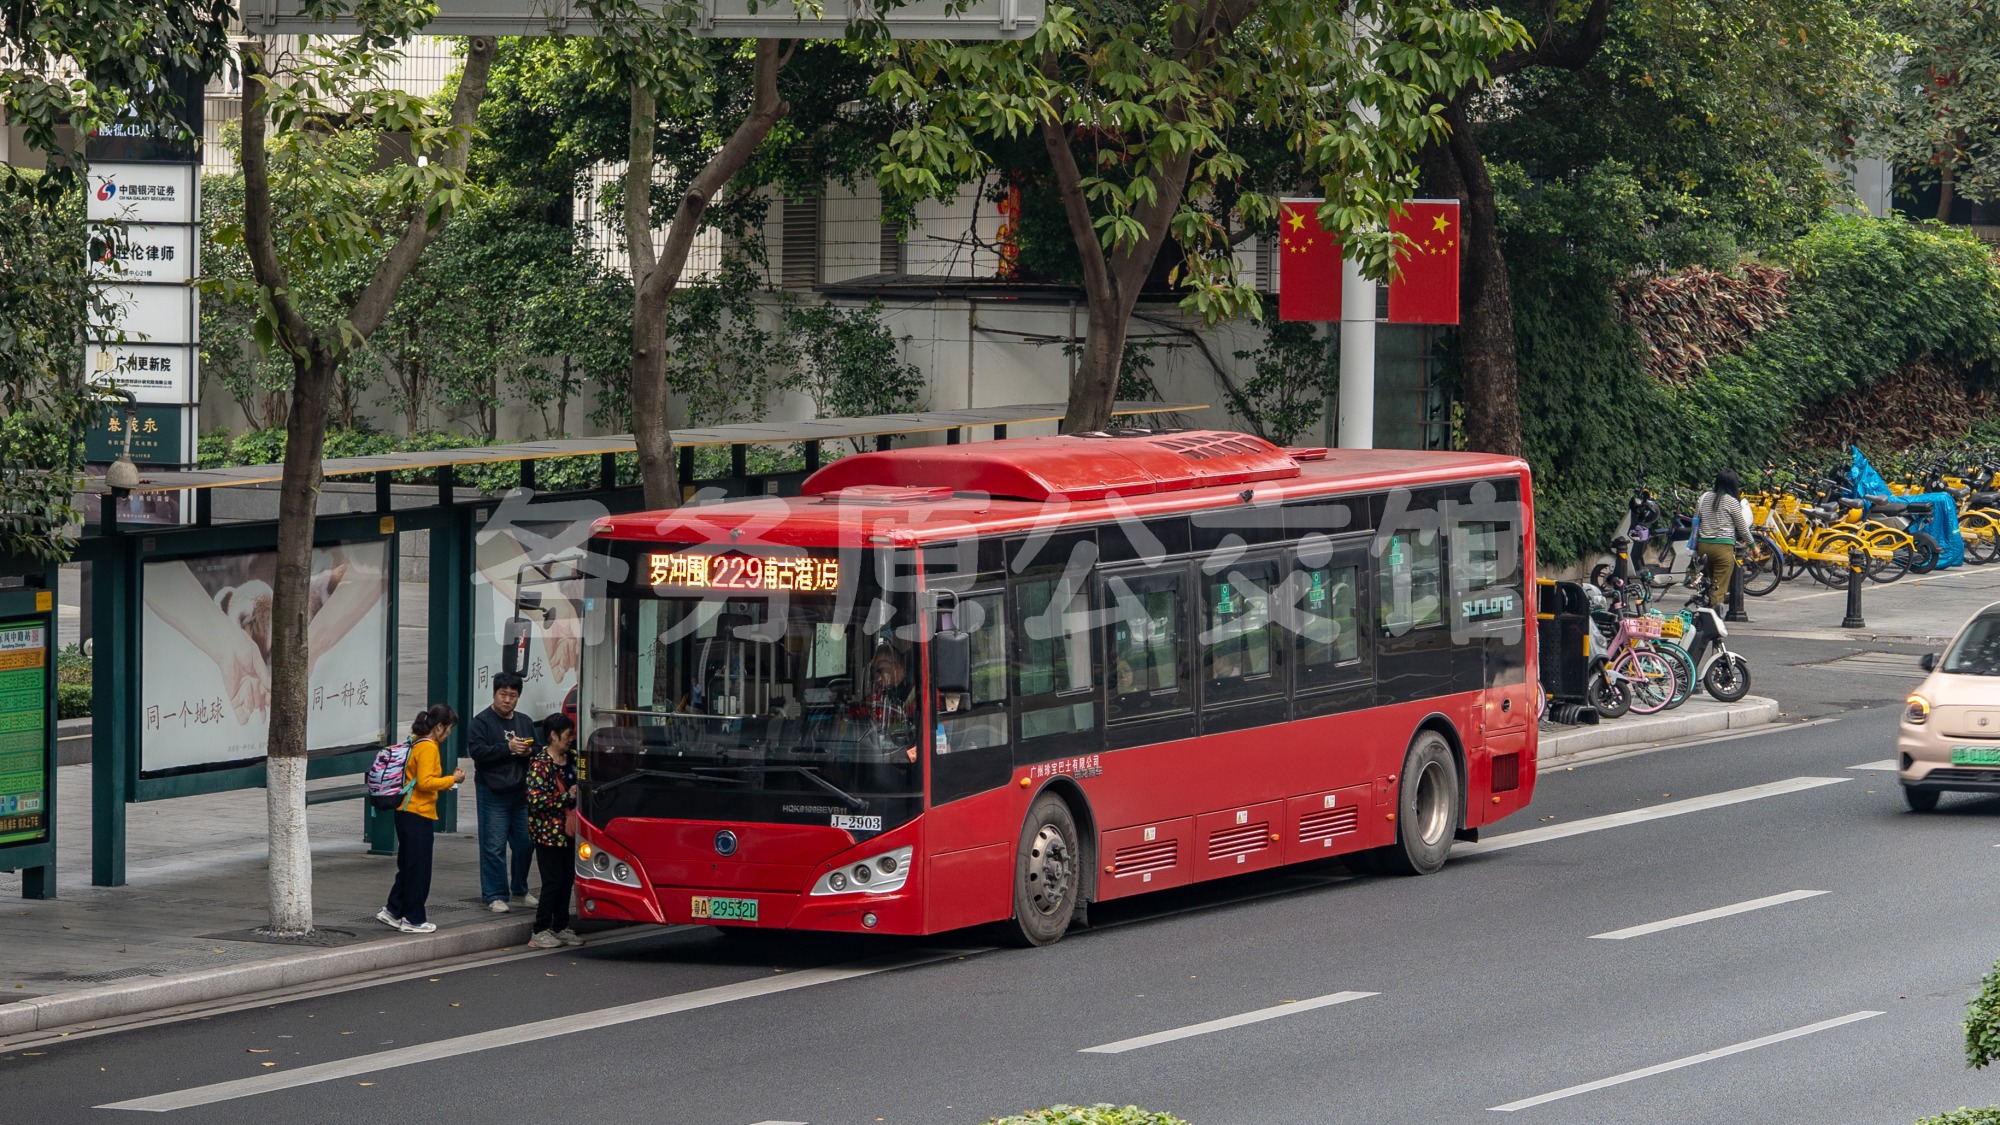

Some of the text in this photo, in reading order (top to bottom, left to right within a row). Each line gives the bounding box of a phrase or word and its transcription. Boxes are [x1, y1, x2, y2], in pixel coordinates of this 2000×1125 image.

[119, 184, 175, 196] 中国银河证券
[1462, 595, 1513, 617] SUNLONG
[312, 678, 370, 711] 同一种爱
[146, 696, 225, 731] 同一个地球
[1030, 755, 1099, 778] 广州珍宝巴士有限公司
[832, 816, 880, 830] J-2903
